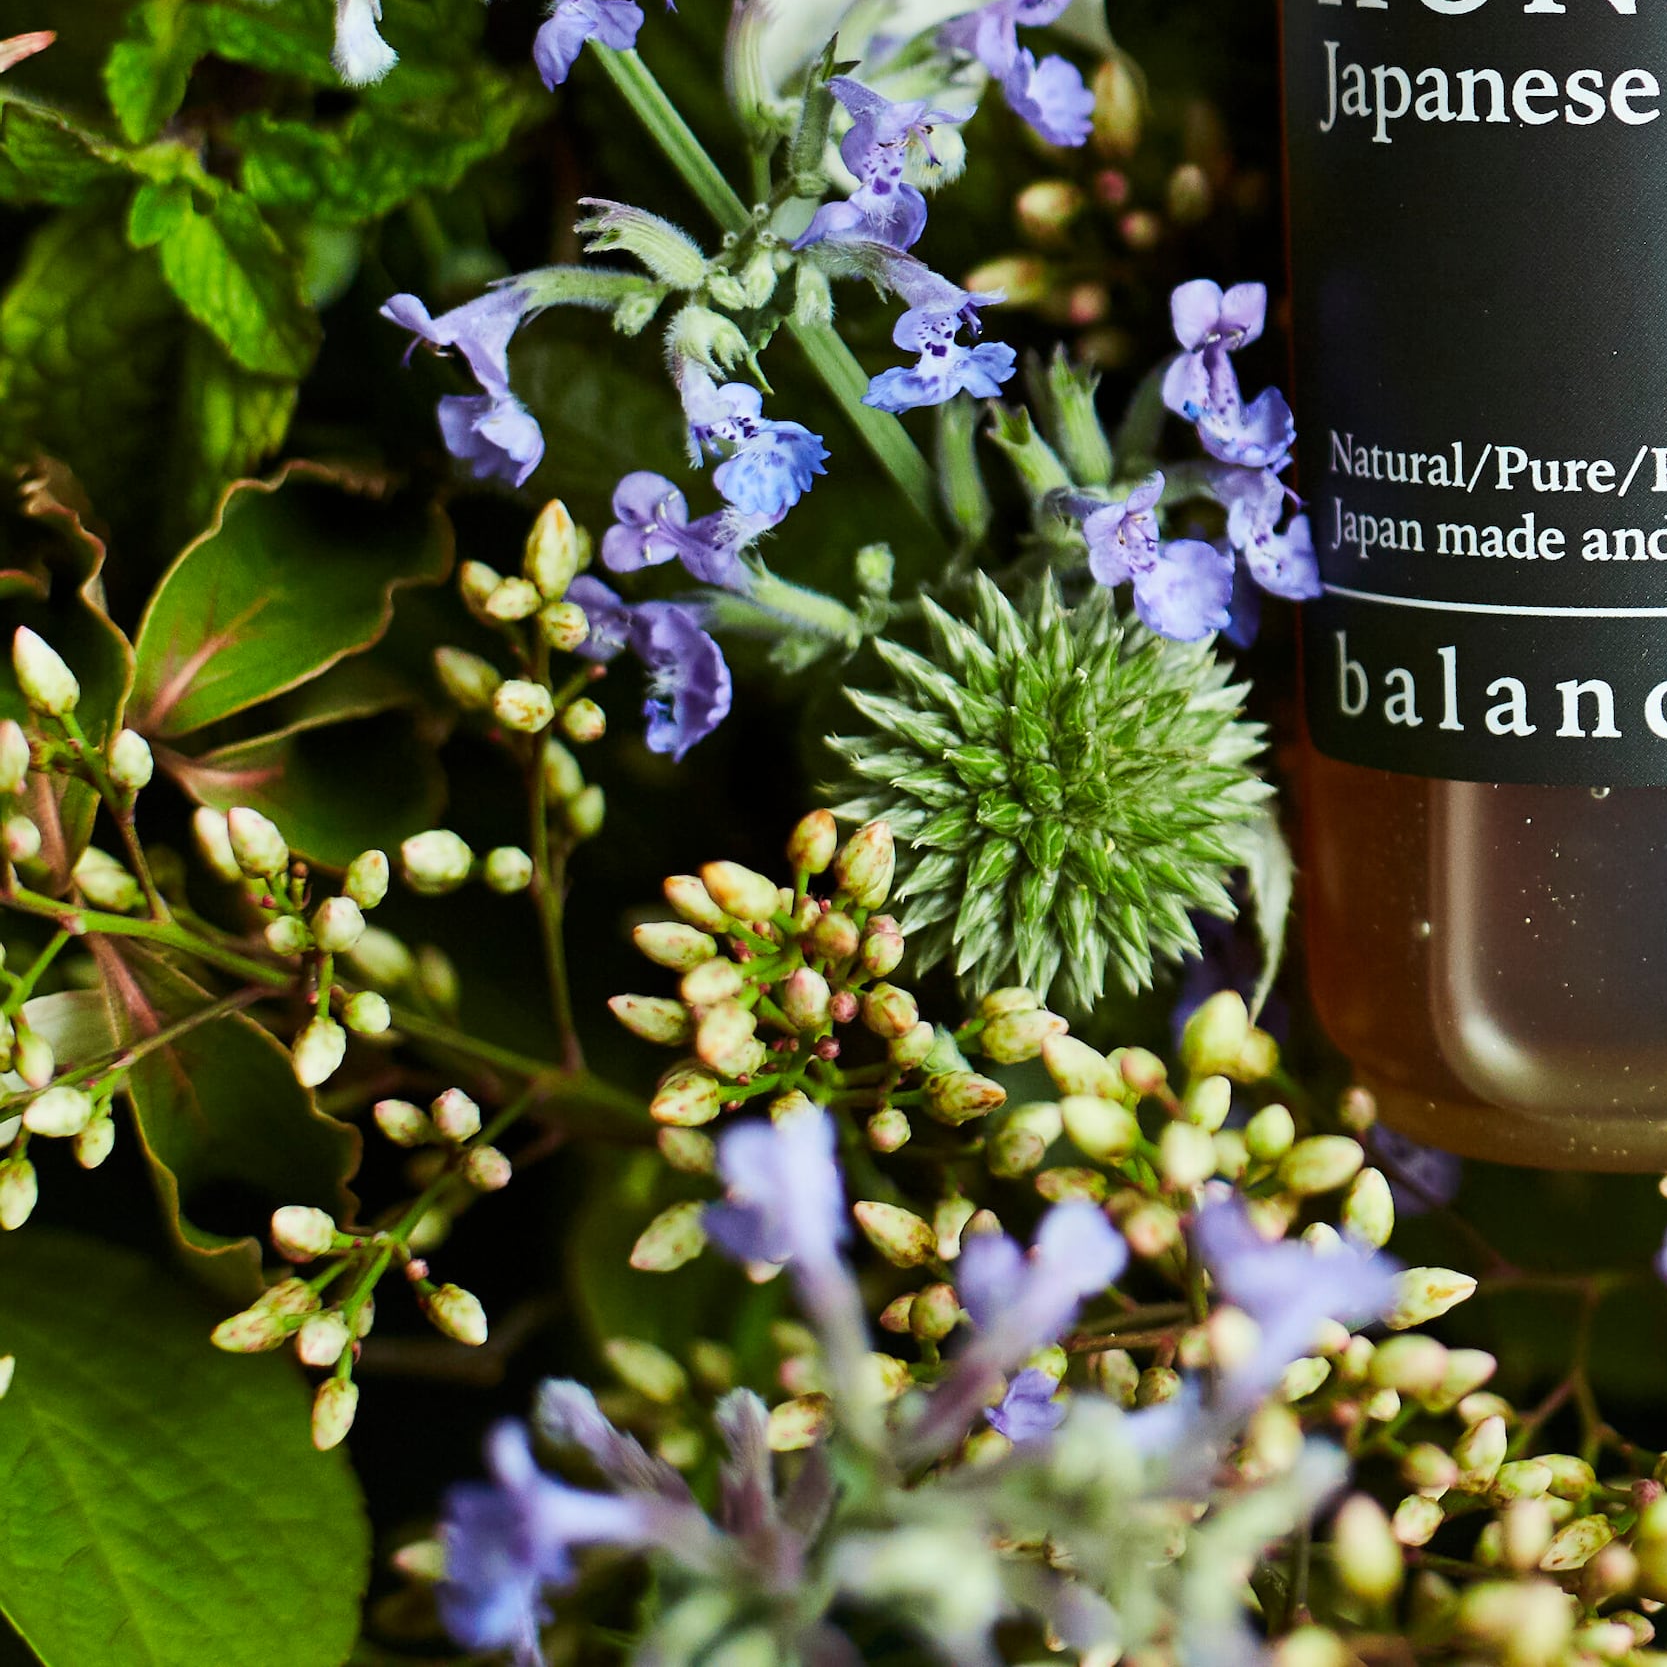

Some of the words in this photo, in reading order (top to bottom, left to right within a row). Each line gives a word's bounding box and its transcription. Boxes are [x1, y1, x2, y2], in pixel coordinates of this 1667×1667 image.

[1320, 40, 1661, 143] Japanese
[1331, 496, 1426, 558] Japan
[1436, 511, 1566, 561] made
